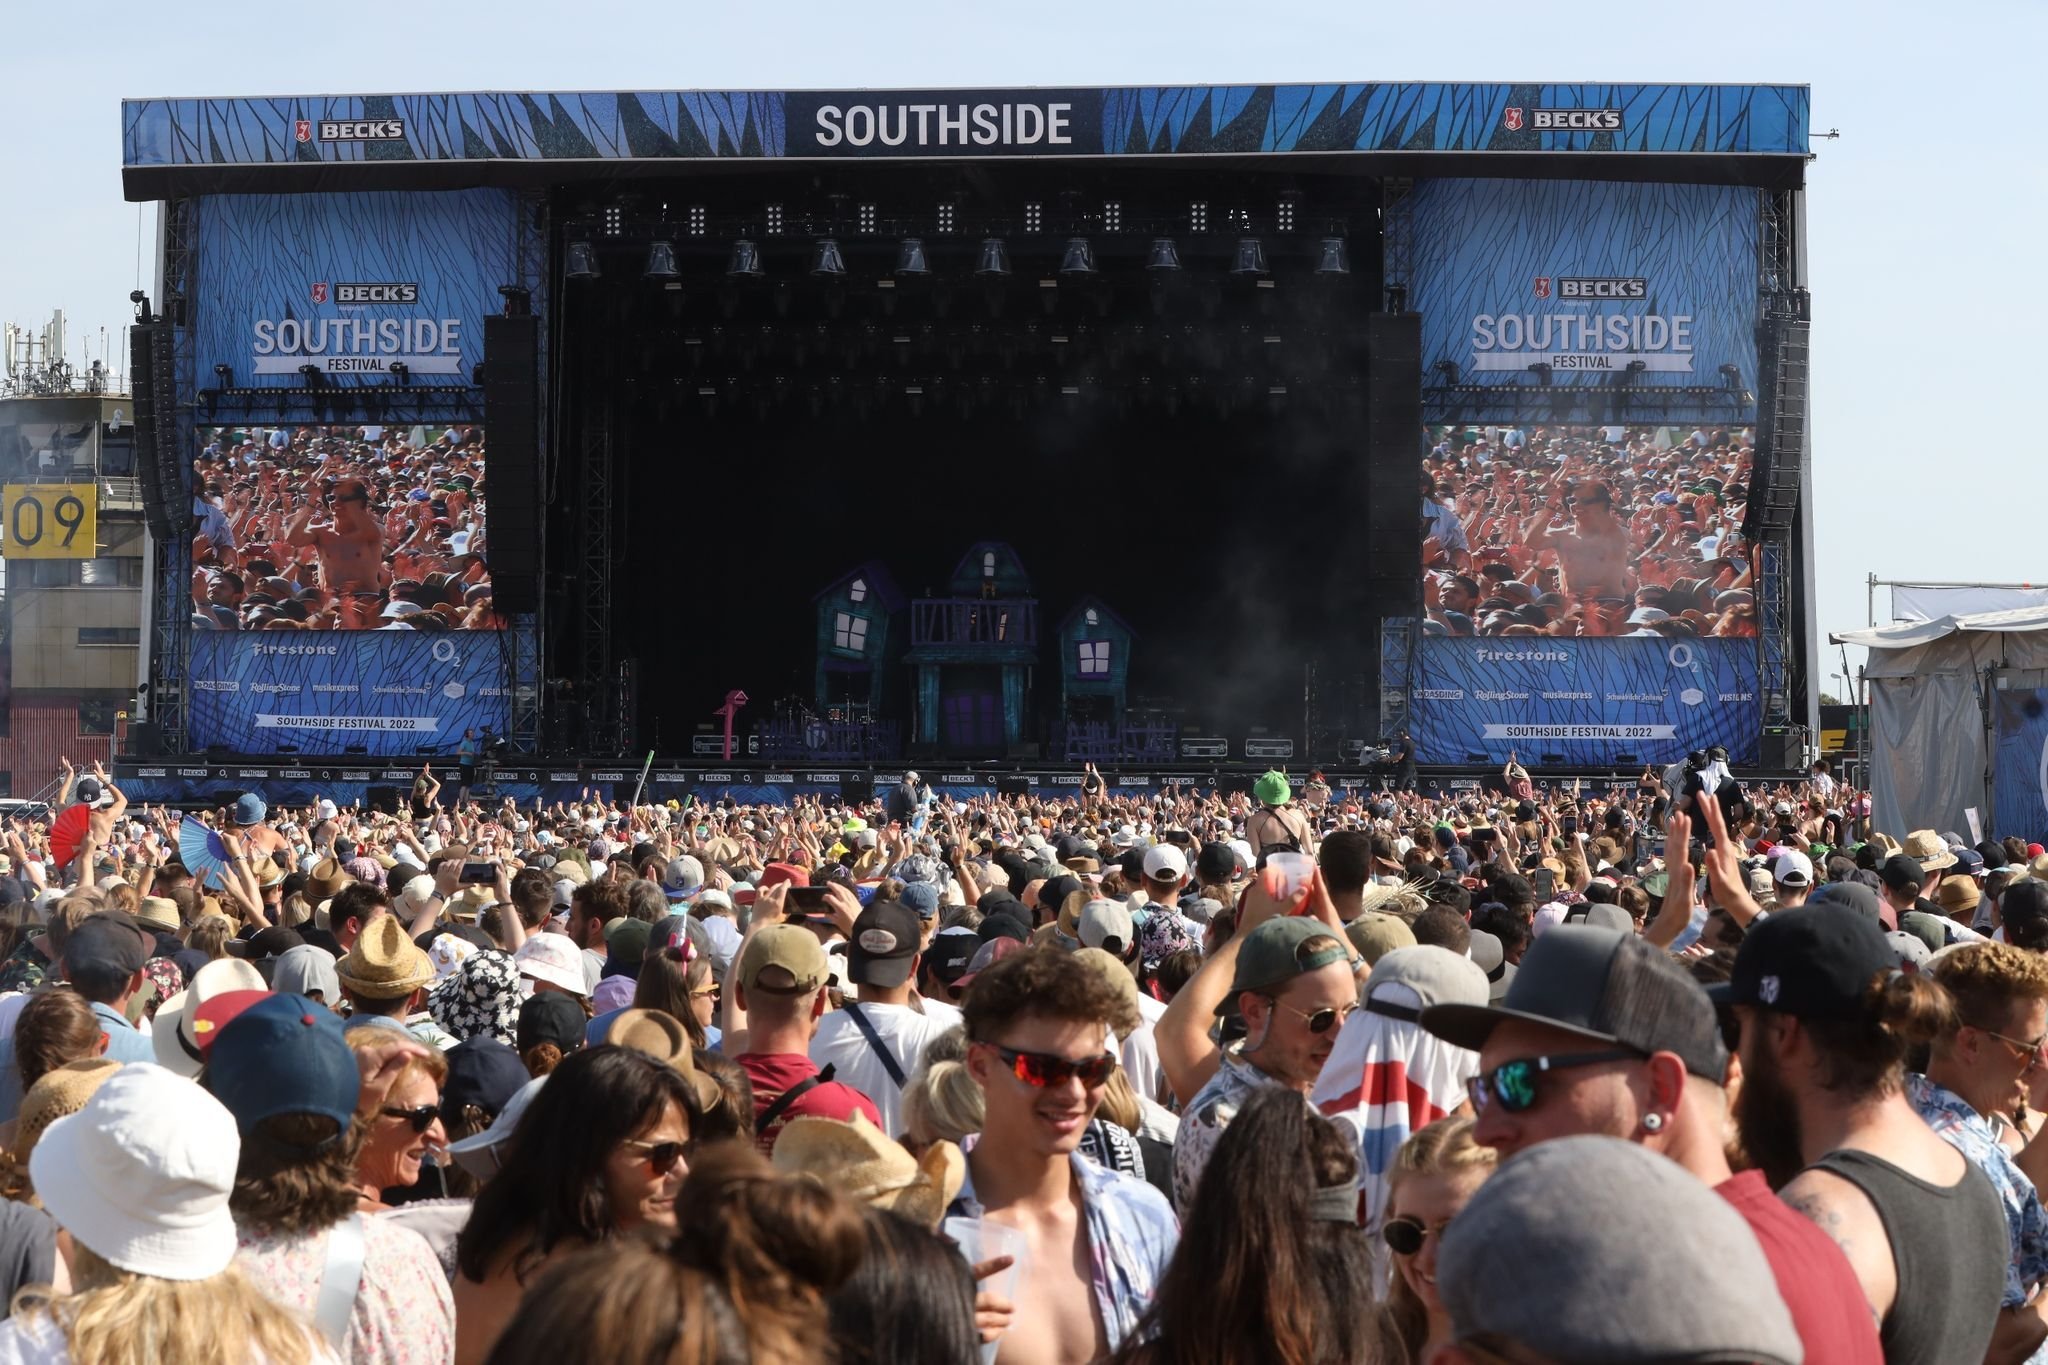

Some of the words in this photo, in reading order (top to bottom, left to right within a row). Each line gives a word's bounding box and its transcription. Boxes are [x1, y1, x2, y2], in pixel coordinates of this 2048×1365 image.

[815, 103, 1072, 146] SOUTHSIDE
[1534, 110, 1620, 128] BECK'S
[322, 120, 402, 138] BECK'S
[338, 284, 416, 300] BECK'S
[1562, 279, 1644, 296] BECK'S
[253, 319, 460, 353] SOUTHSIDE
[1472, 314, 1692, 350] SOUTHSIDE
[328, 358, 385, 371] FESTIVAL
[1553, 355, 1612, 369] FESTIVAL
[13, 496, 84, 546] 09
[252, 643, 337, 656] Firestone
[1475, 649, 1569, 663] Firestone
[312, 684, 359, 693] musikexpress
[1543, 690, 1592, 700] musikexpress
[277, 717, 335, 728] SOUTHSIDE
[338, 718, 386, 729] FESTIVAL
[390, 719, 415, 729] 2022
[1506, 726, 1567, 737] SOUTHSIDE
[1571, 727, 1622, 737] FESTIVAL
[1625, 727, 1652, 737] 2022
